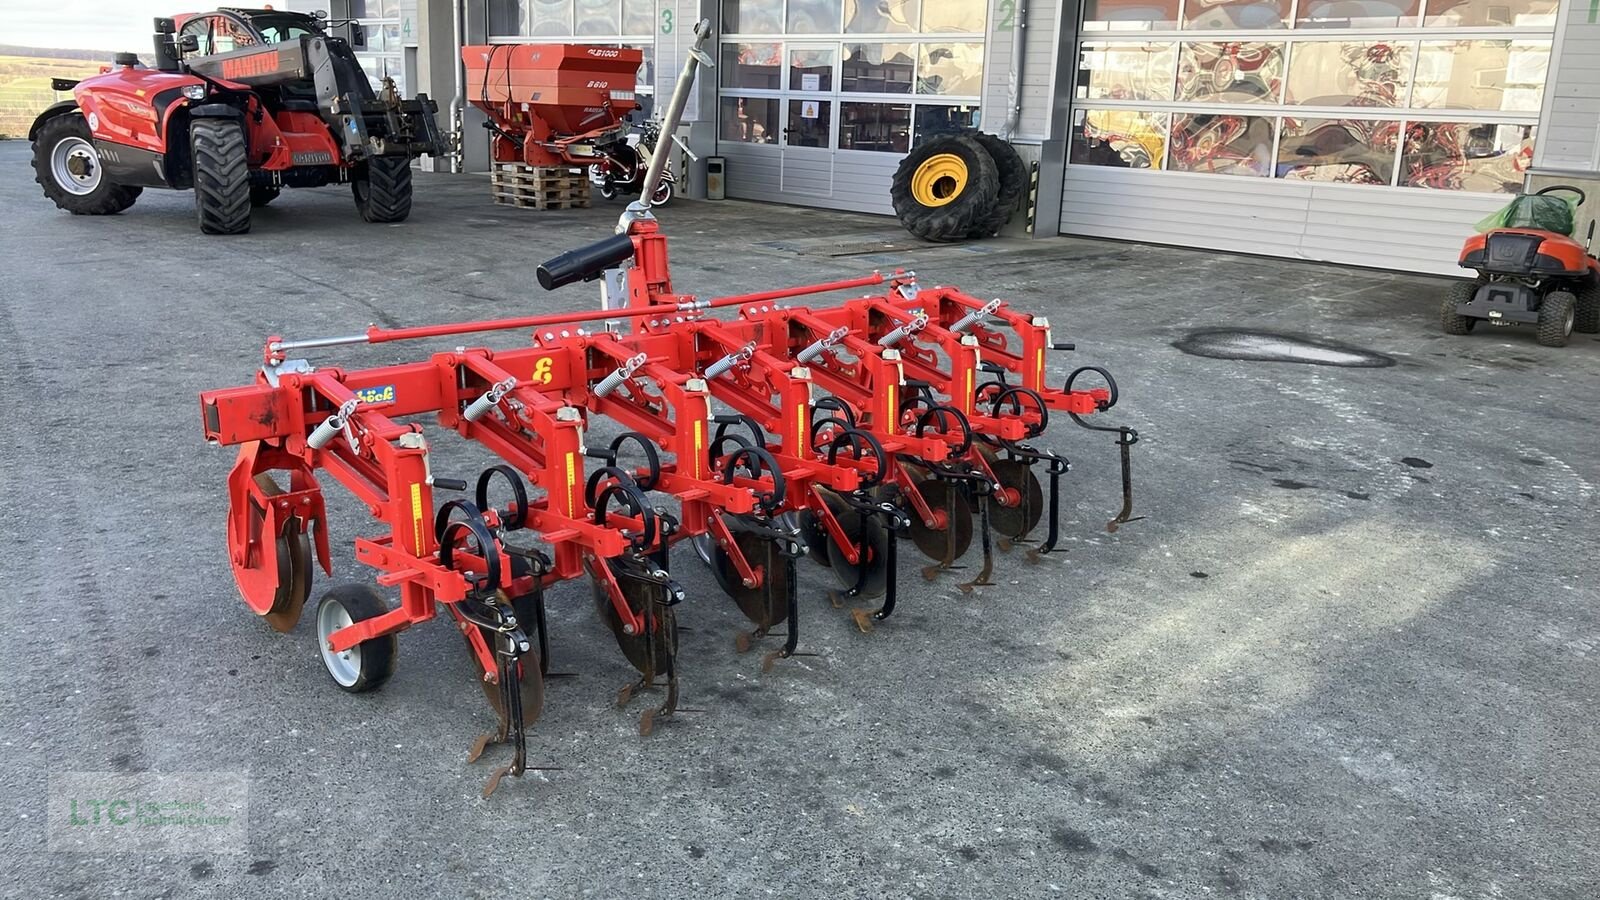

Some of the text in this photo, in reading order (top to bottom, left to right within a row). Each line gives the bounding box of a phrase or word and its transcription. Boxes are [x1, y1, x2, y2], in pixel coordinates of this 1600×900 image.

[403, 17, 411, 37] 4
[661, 9, 673, 34] 3
[998, 0, 1015, 31] 2
[223, 50, 278, 79] MANITOU
